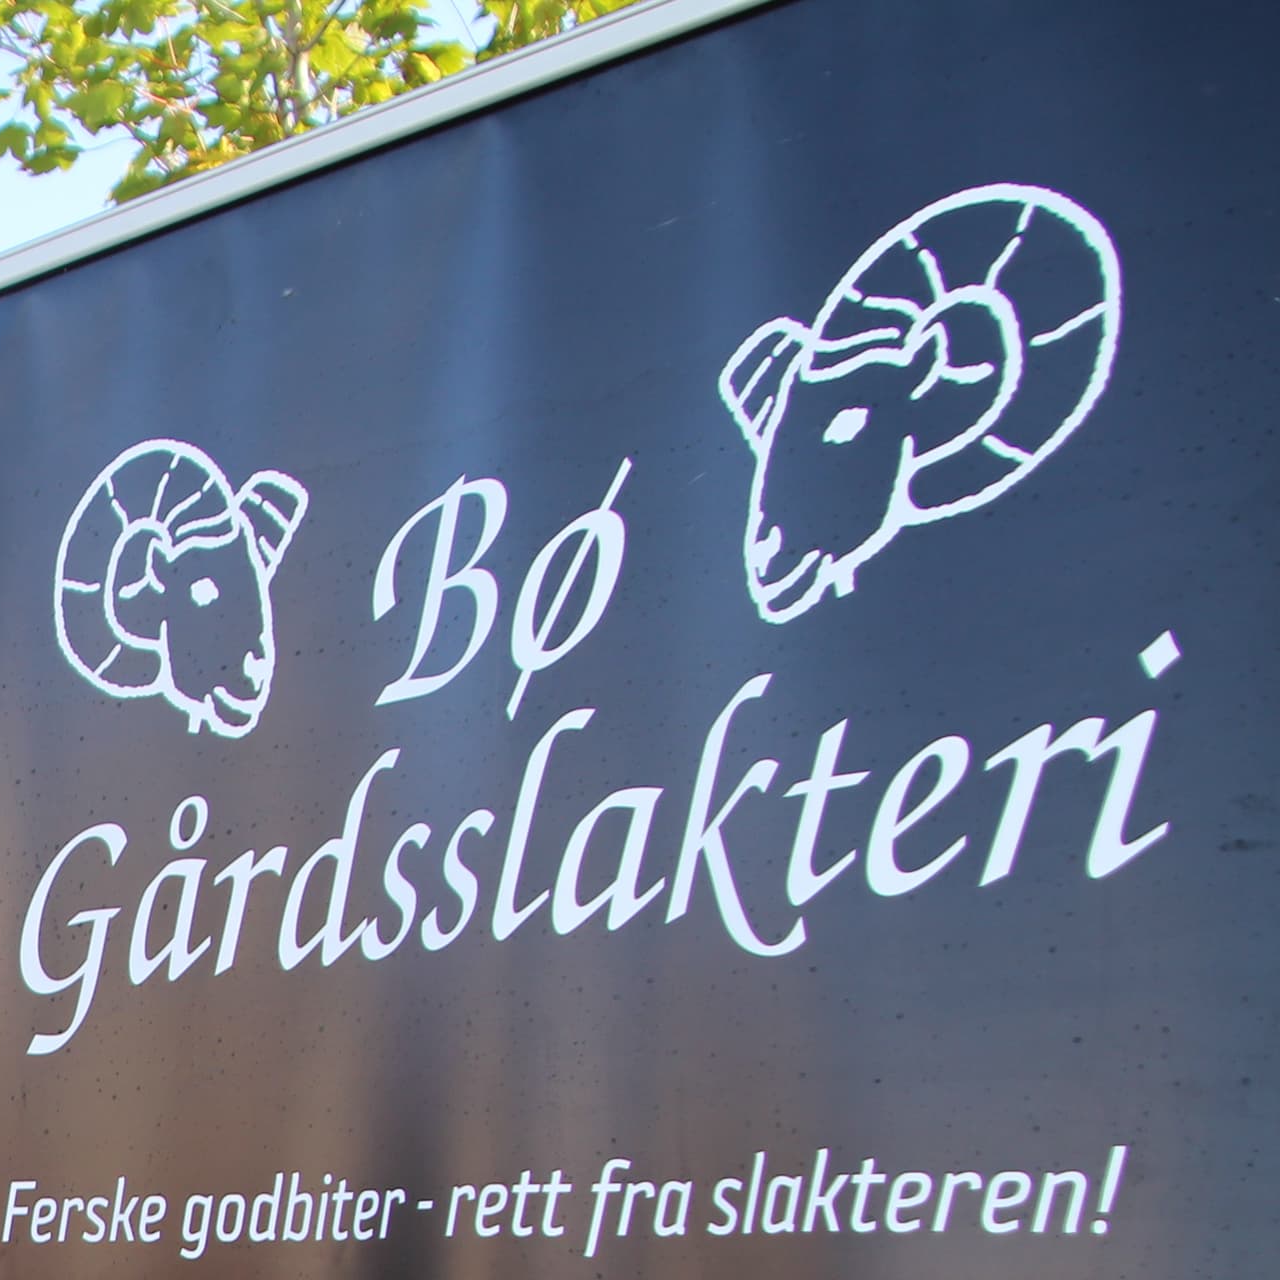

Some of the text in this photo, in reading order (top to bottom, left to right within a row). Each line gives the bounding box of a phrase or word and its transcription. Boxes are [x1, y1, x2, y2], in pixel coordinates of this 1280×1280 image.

[372, 457, 632, 721] Bø
[19, 630, 1182, 1056] Gårdsslakteri
[1, 1175, 167, 1243] Ferske
[179, 1171, 406, 1260] godbiter
[445, 1169, 573, 1238] rett
[583, 1158, 693, 1258] fra
[706, 1145, 1127, 1236] slakteren!
